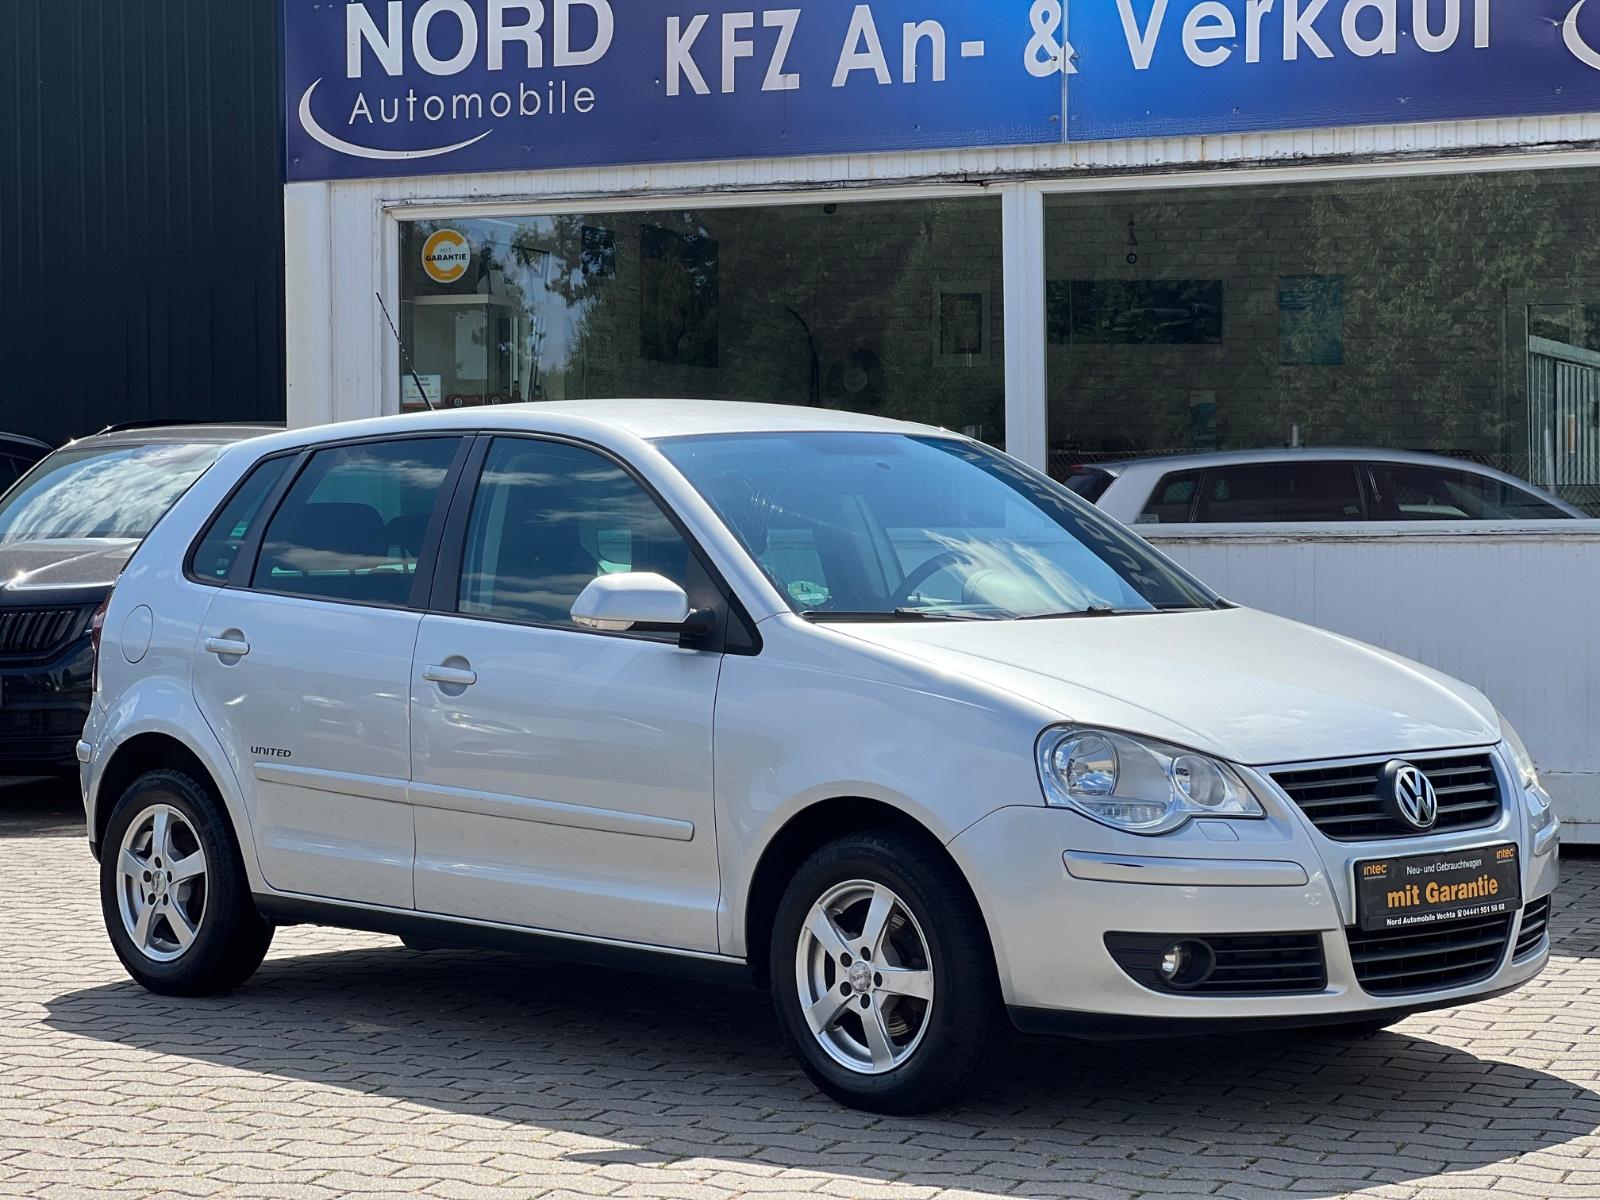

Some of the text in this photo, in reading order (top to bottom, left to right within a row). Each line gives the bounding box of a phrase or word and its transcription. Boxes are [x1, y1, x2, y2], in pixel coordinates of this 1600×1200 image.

[346, 0, 615, 79] NORD
[666, 8, 801, 97] KFZ
[1023, 0, 1079, 78] &
[348, 80, 596, 126] Automobile
[425, 253, 466, 262] GARANTIE
[250, 745, 291, 757] UNITED
[1496, 848, 1514, 859] intec
[1364, 864, 1387, 876] intec
[1406, 859, 1482, 875] Neu- und Gebrauchtwagen
[1387, 874, 1499, 908] mit Garantie
[1386, 917, 1402, 926] Nord
[1402, 913, 1436, 924] Automobile
[1436, 911, 1456, 920] Vechta
